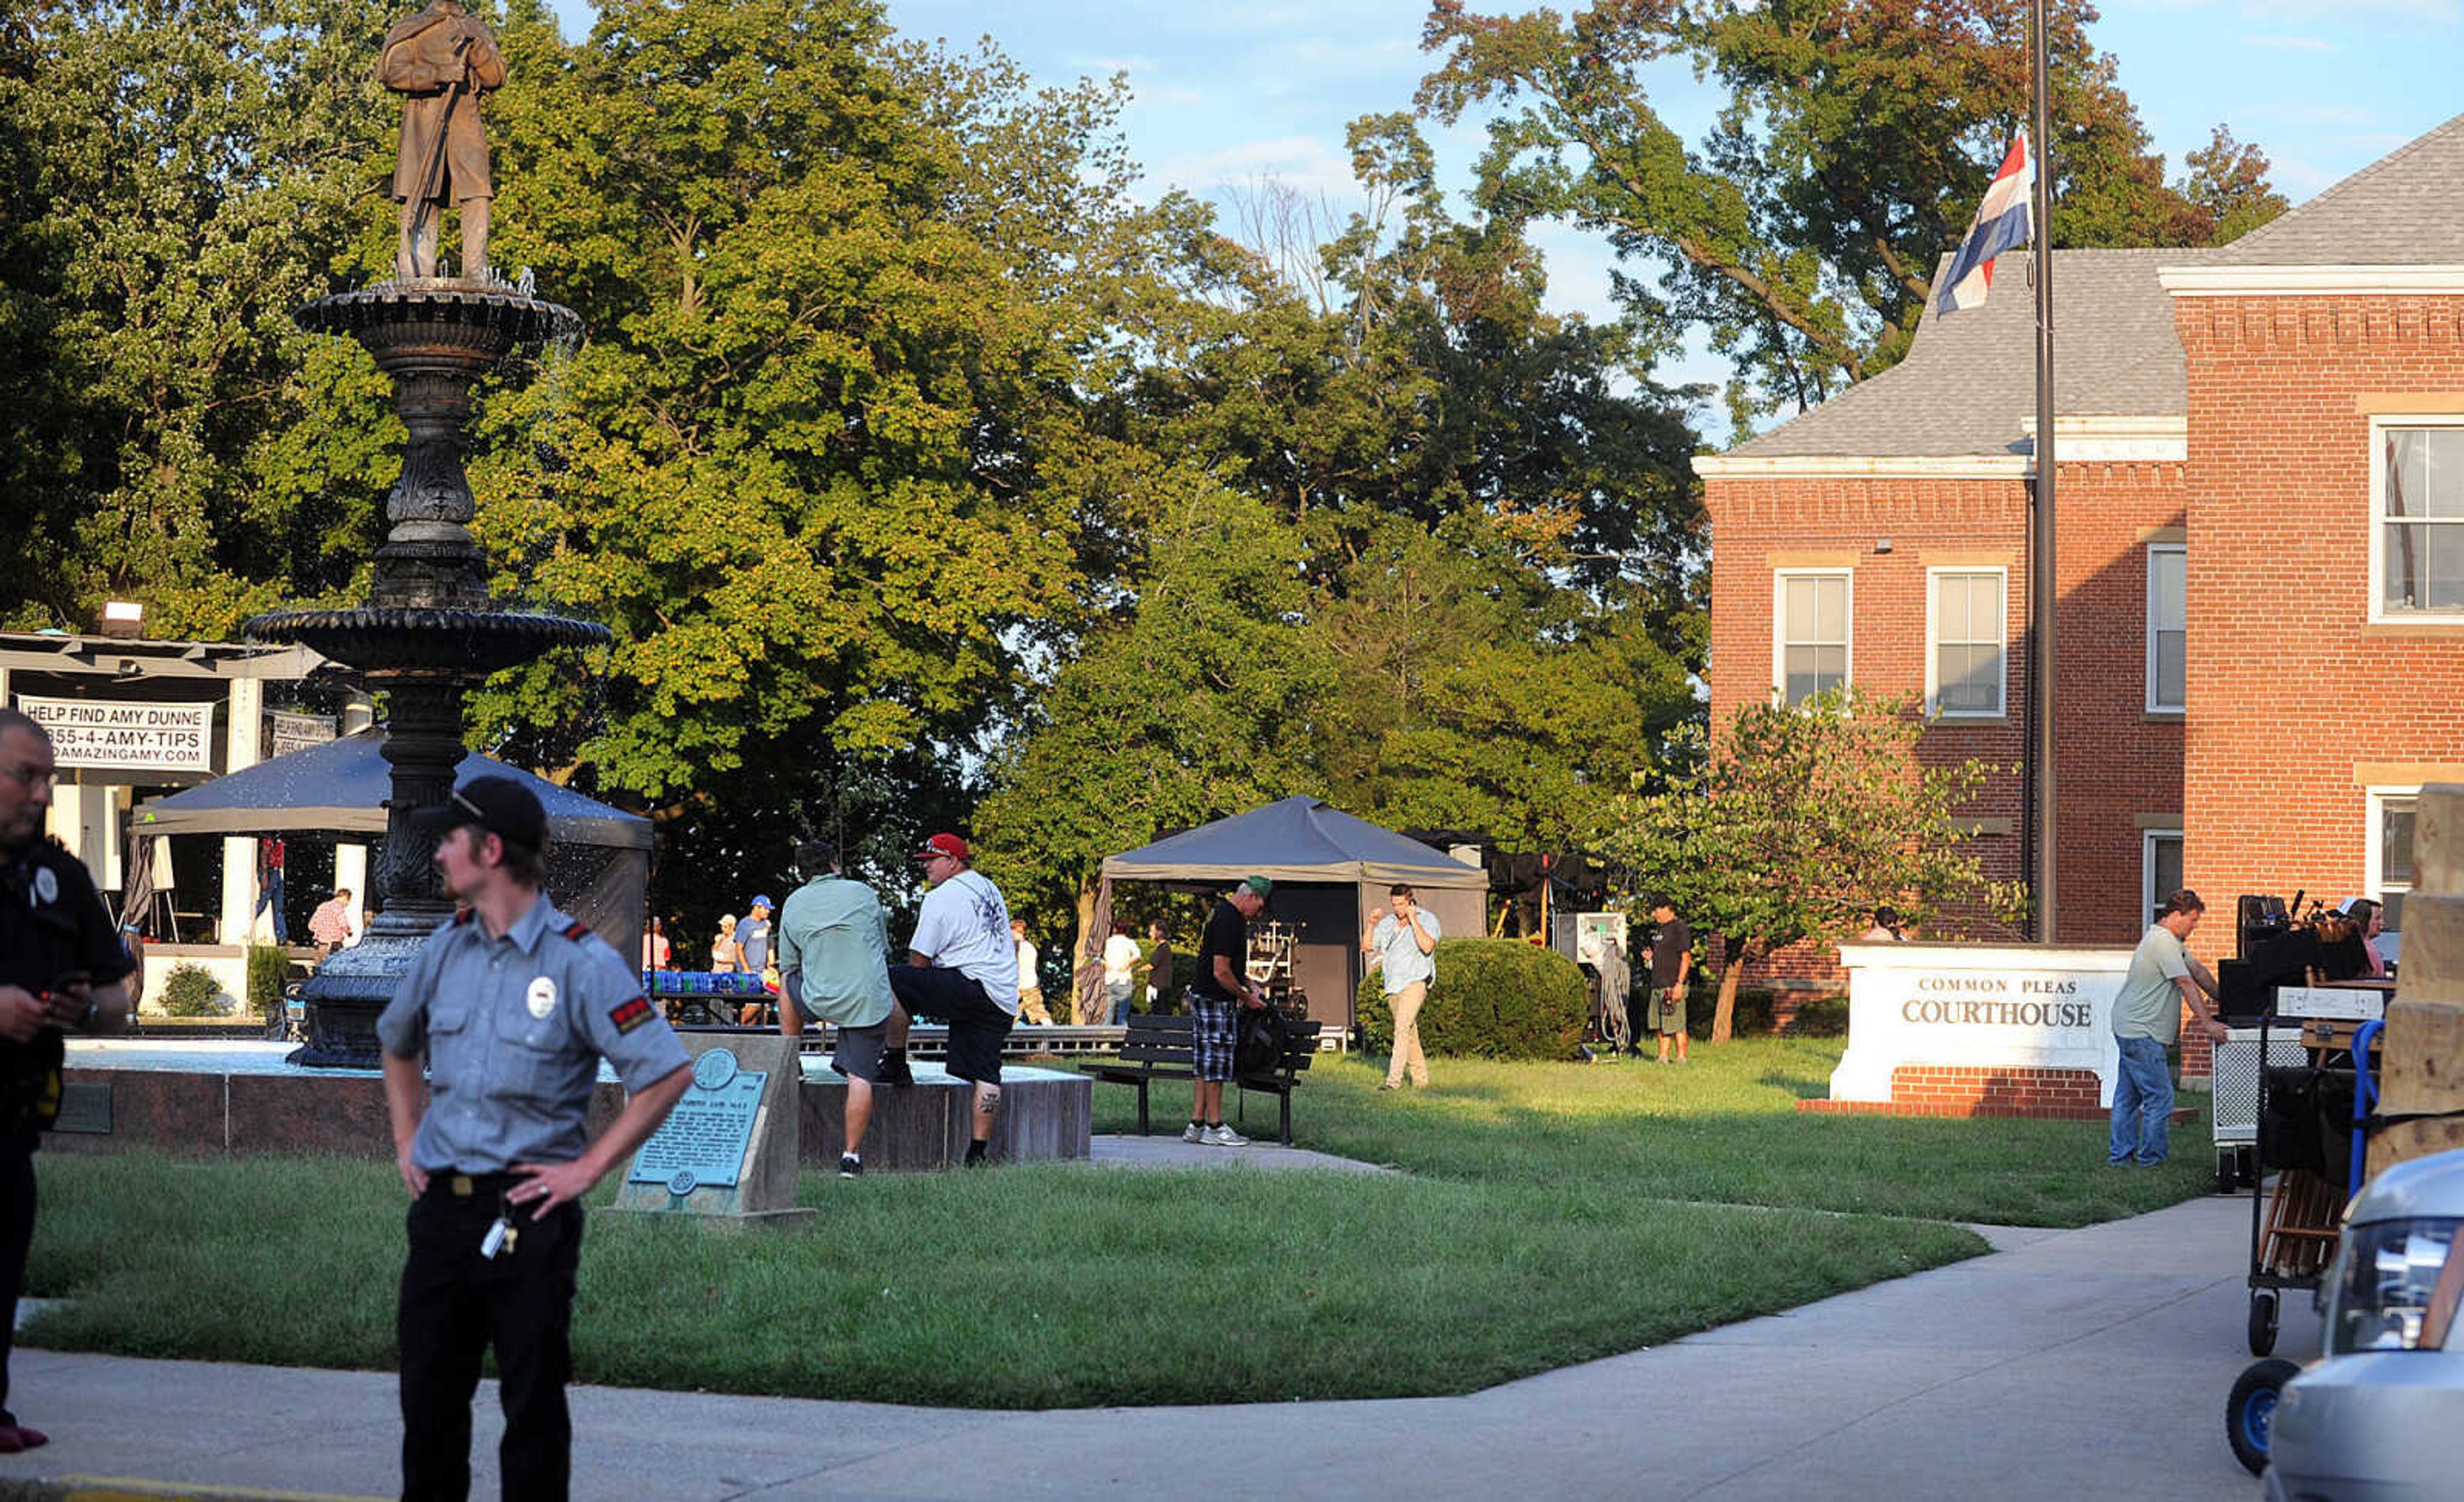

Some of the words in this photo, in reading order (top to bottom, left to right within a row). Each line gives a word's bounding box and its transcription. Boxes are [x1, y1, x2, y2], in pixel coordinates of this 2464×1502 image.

[28, 706, 65, 721] HELP
[70, 709, 105, 723] FIND
[109, 710, 144, 725] AMY
[148, 711, 201, 725] DUNNE
[1919, 978, 2007, 992] COMMON
[2022, 980, 2076, 994] PLEAS
[1901, 999, 2092, 1027] COURTHOUSE
